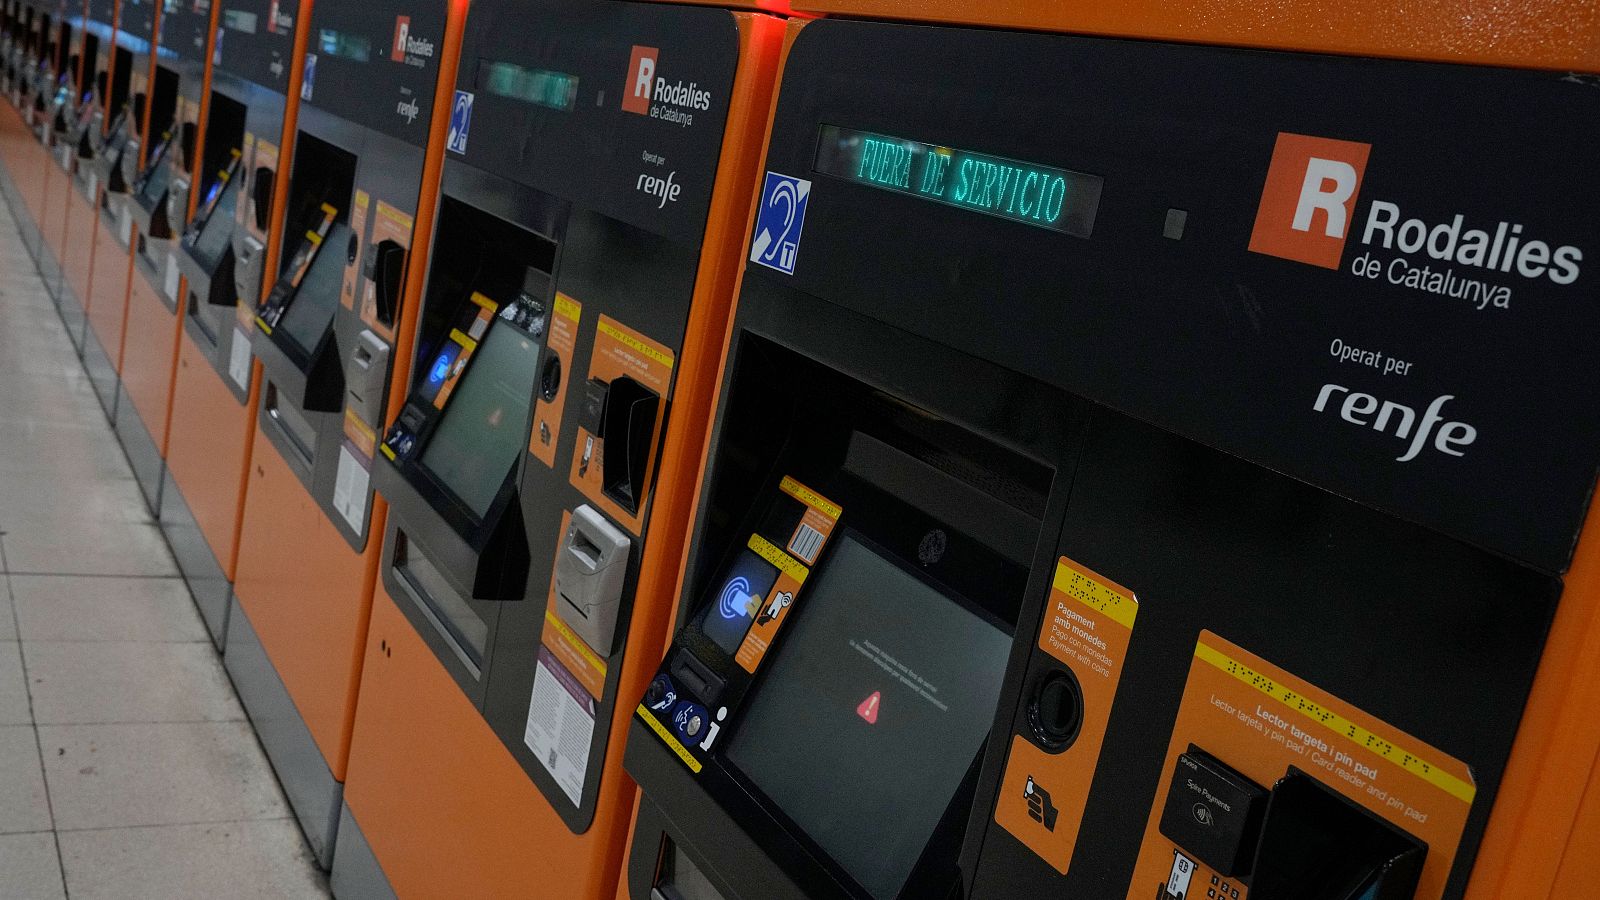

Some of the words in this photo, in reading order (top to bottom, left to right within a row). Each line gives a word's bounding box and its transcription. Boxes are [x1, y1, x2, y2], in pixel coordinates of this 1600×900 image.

[634, 57, 655, 99] R
[653, 77, 711, 111] Rodalies
[659, 106, 693, 128] Catalunya
[636, 171, 681, 209] renfe
[858, 139, 913, 187] FUERA
[921, 151, 951, 196] DE
[955, 158, 1066, 222] SERVICIO
[1292, 157, 1357, 239] R
[1360, 199, 1584, 285] Rodalies
[1351, 251, 1381, 280] de
[1387, 257, 1513, 310] Catalunya
[1330, 338, 1382, 369] Operat
[1384, 355, 1413, 376] per
[1312, 383, 1478, 462] renfe
[1055, 615, 1071, 630] amb
[1072, 625, 1107, 651] monedes
[1057, 602, 1096, 630] Pagament
[1048, 635, 1077, 658] Payment
[1077, 653, 1091, 667] with
[1091, 662, 1110, 678] coins
[1051, 625, 1069, 641] Pago
[1069, 636, 1082, 649] con
[1083, 644, 1113, 667] monedas
[1210, 694, 1237, 715] Lector
[1237, 710, 1263, 732] tarjeta
[1263, 727, 1270, 736] y
[1271, 732, 1285, 744] pin
[1286, 739, 1305, 755] pad
[1311, 751, 1336, 771] Card
[1335, 767, 1367, 789] reader
[1366, 784, 1389, 801] and
[1386, 796, 1405, 812] pin
[1404, 806, 1429, 824] pad
[1256, 705, 1289, 730] Lector
[1291, 724, 1328, 753] targeta
[1335, 751, 1353, 767] pin
[1354, 761, 1378, 780] pad
[1186, 778, 1202, 795] Spire
[1201, 788, 1232, 813] Payments
